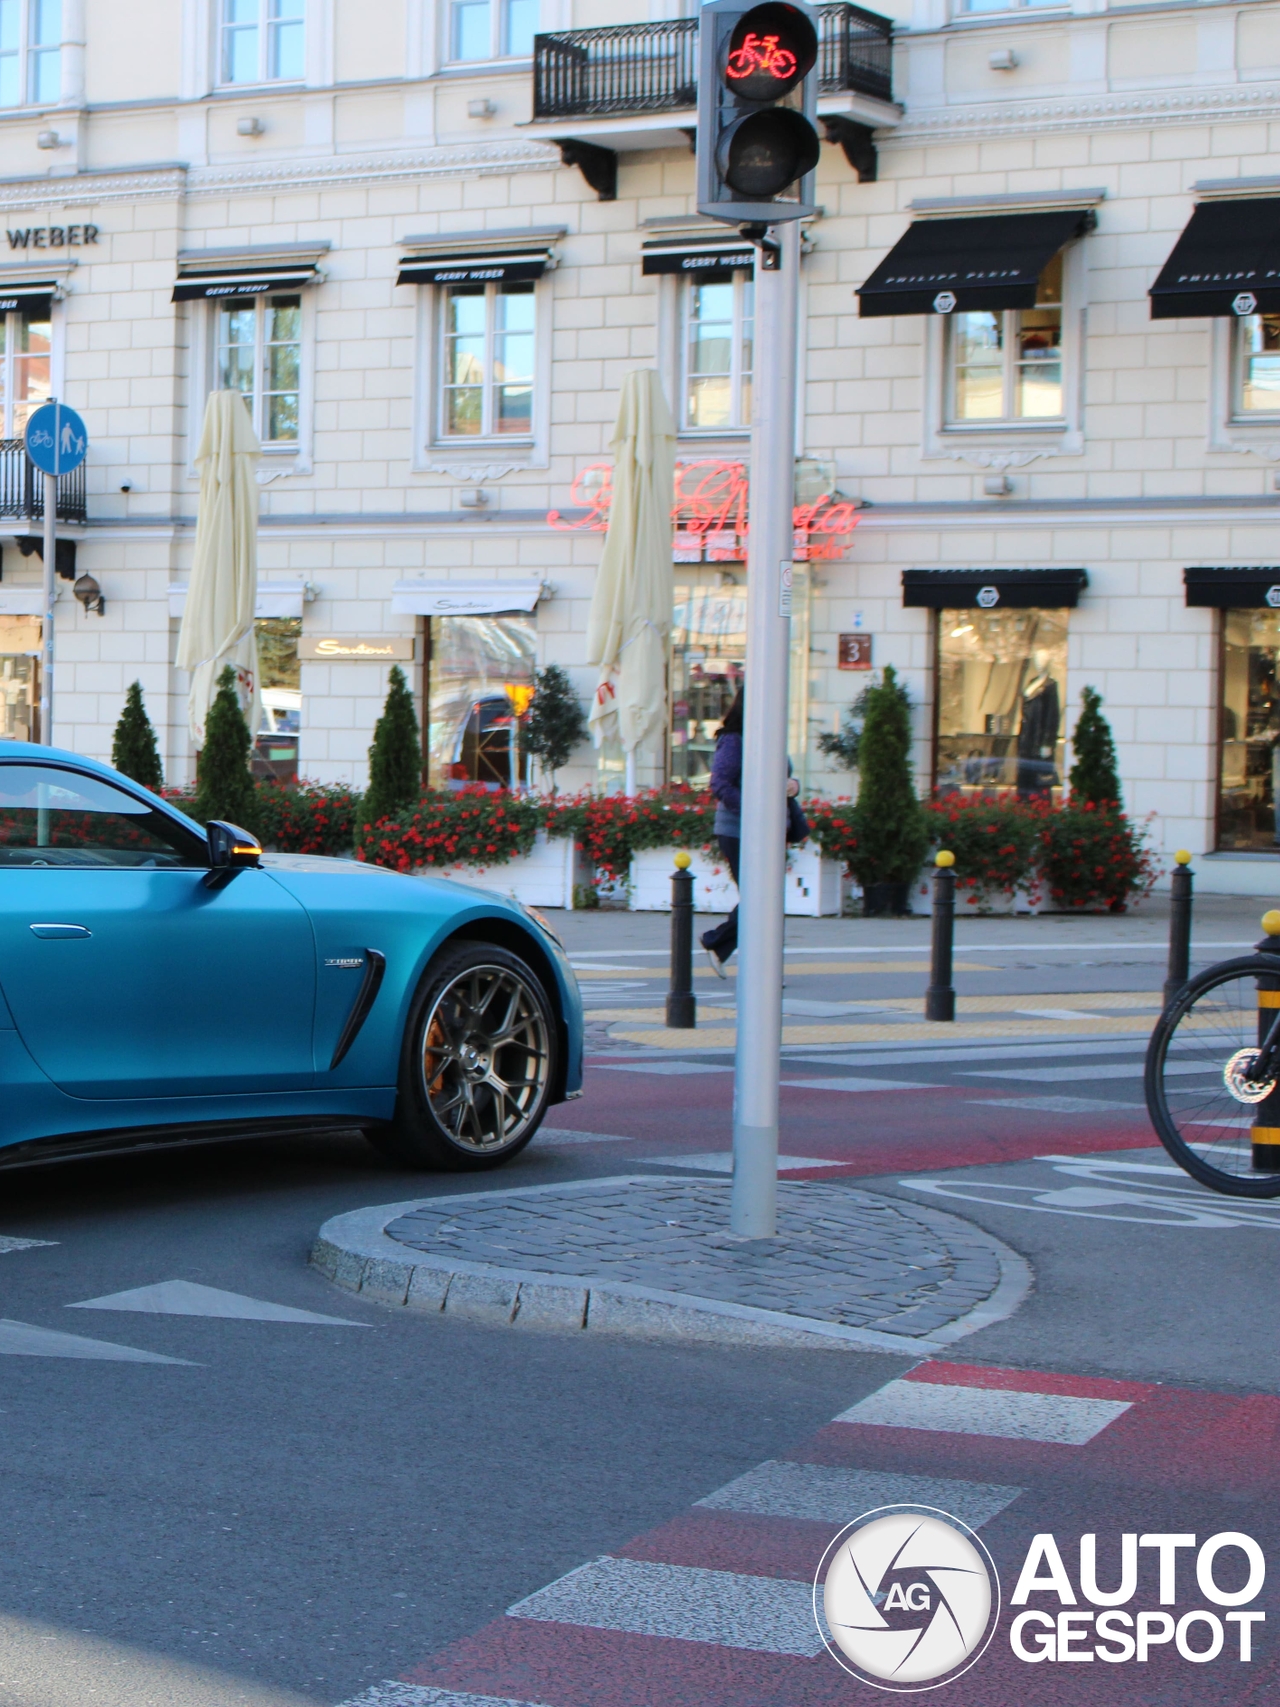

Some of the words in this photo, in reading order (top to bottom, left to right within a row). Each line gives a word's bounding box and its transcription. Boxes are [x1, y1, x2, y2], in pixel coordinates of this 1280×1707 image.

[6, 224, 99, 250] WEBER
[682, 257, 717, 268] GERRY
[434, 272, 468, 281] GERRY
[470, 268, 505, 279] WEBER
[885, 272, 958, 284] PHILIPP
[966, 269, 1020, 280] PLEIN
[1178, 270, 1256, 283] PHILIPP
[205, 286, 236, 296] GERRY
[238, 284, 269, 293] WEBER
[314, 639, 393, 655] Santoni
[847, 643, 860, 662] 3
